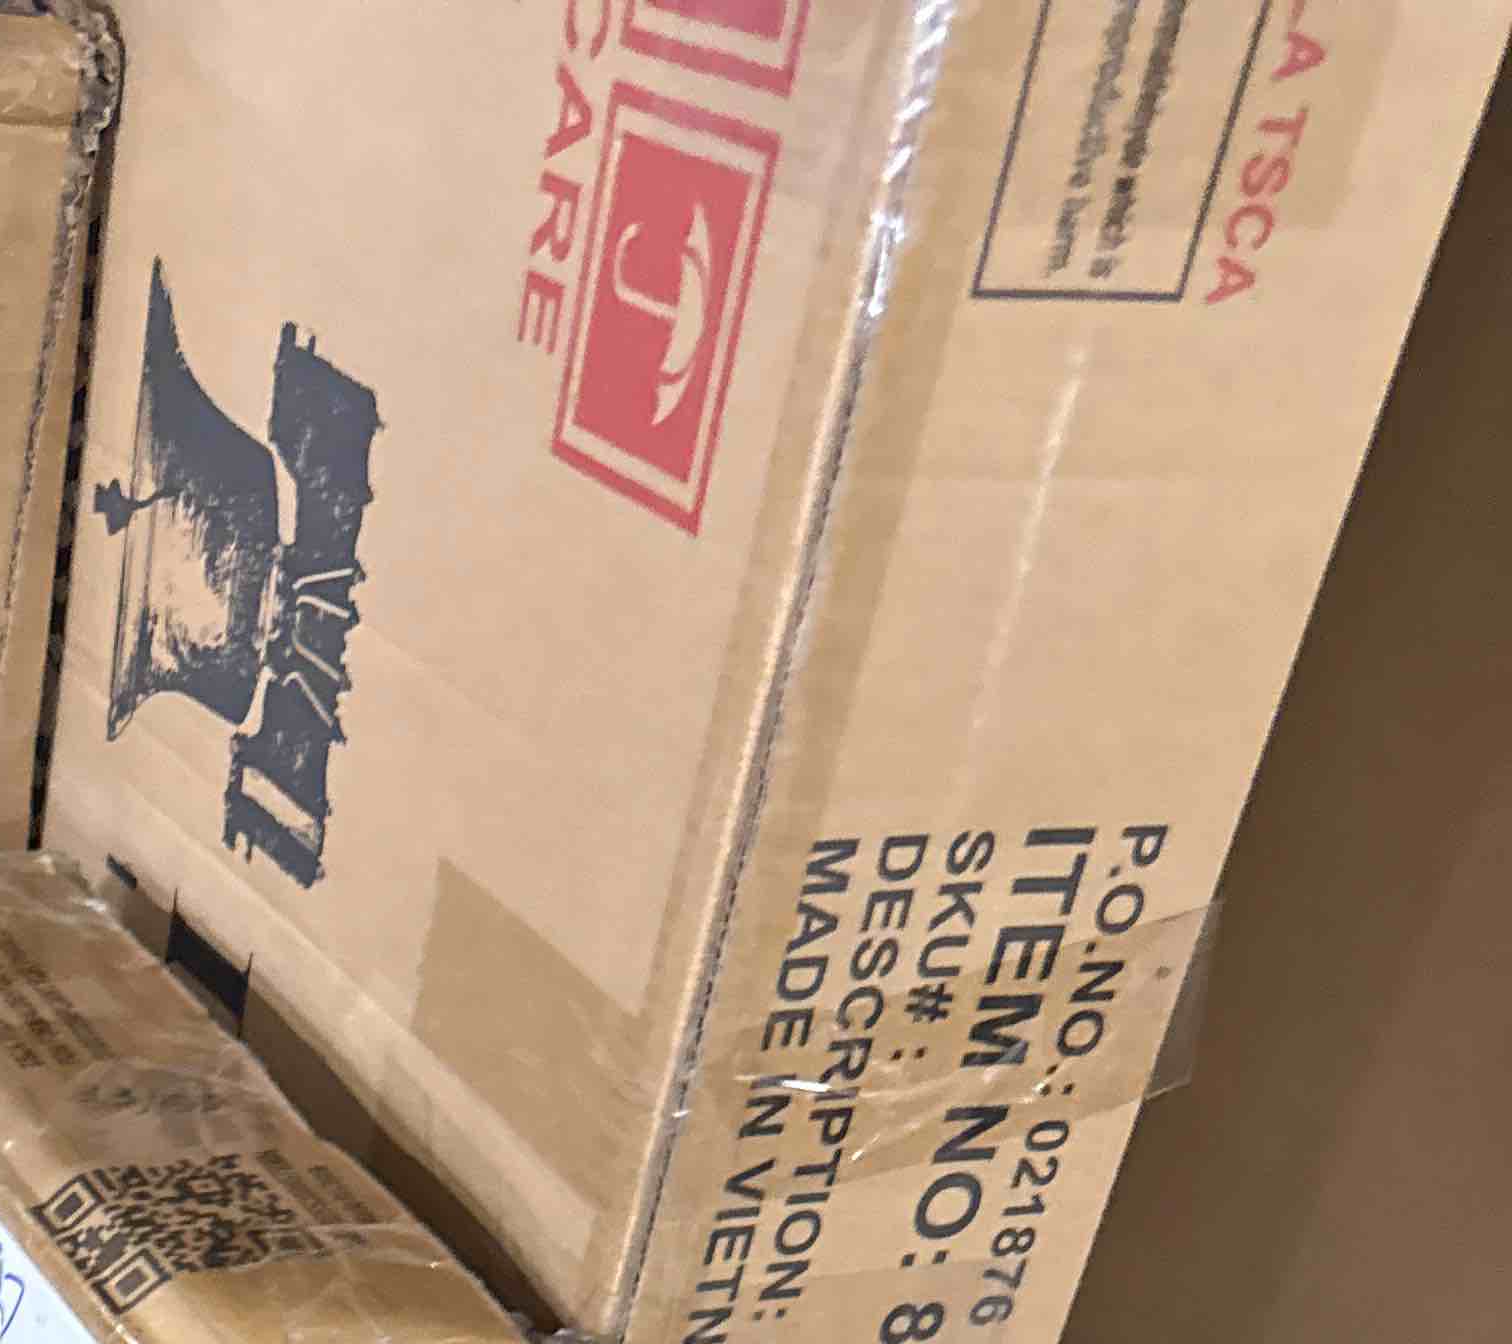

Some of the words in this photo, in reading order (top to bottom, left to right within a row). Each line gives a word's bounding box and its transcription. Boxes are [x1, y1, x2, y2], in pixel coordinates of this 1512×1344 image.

[1205, 104, 1309, 304] TSCA
[759, 837, 861, 1052] MADE
[903, 830, 995, 1024] SKU#
[959, 826, 1097, 1068] ITEM
[736, 1073, 792, 1140] IN
[751, 833, 929, 1322] DESCRIPTION:
[900, 1104, 1011, 1269] NO:
[968, 1118, 1071, 1327] 021876
